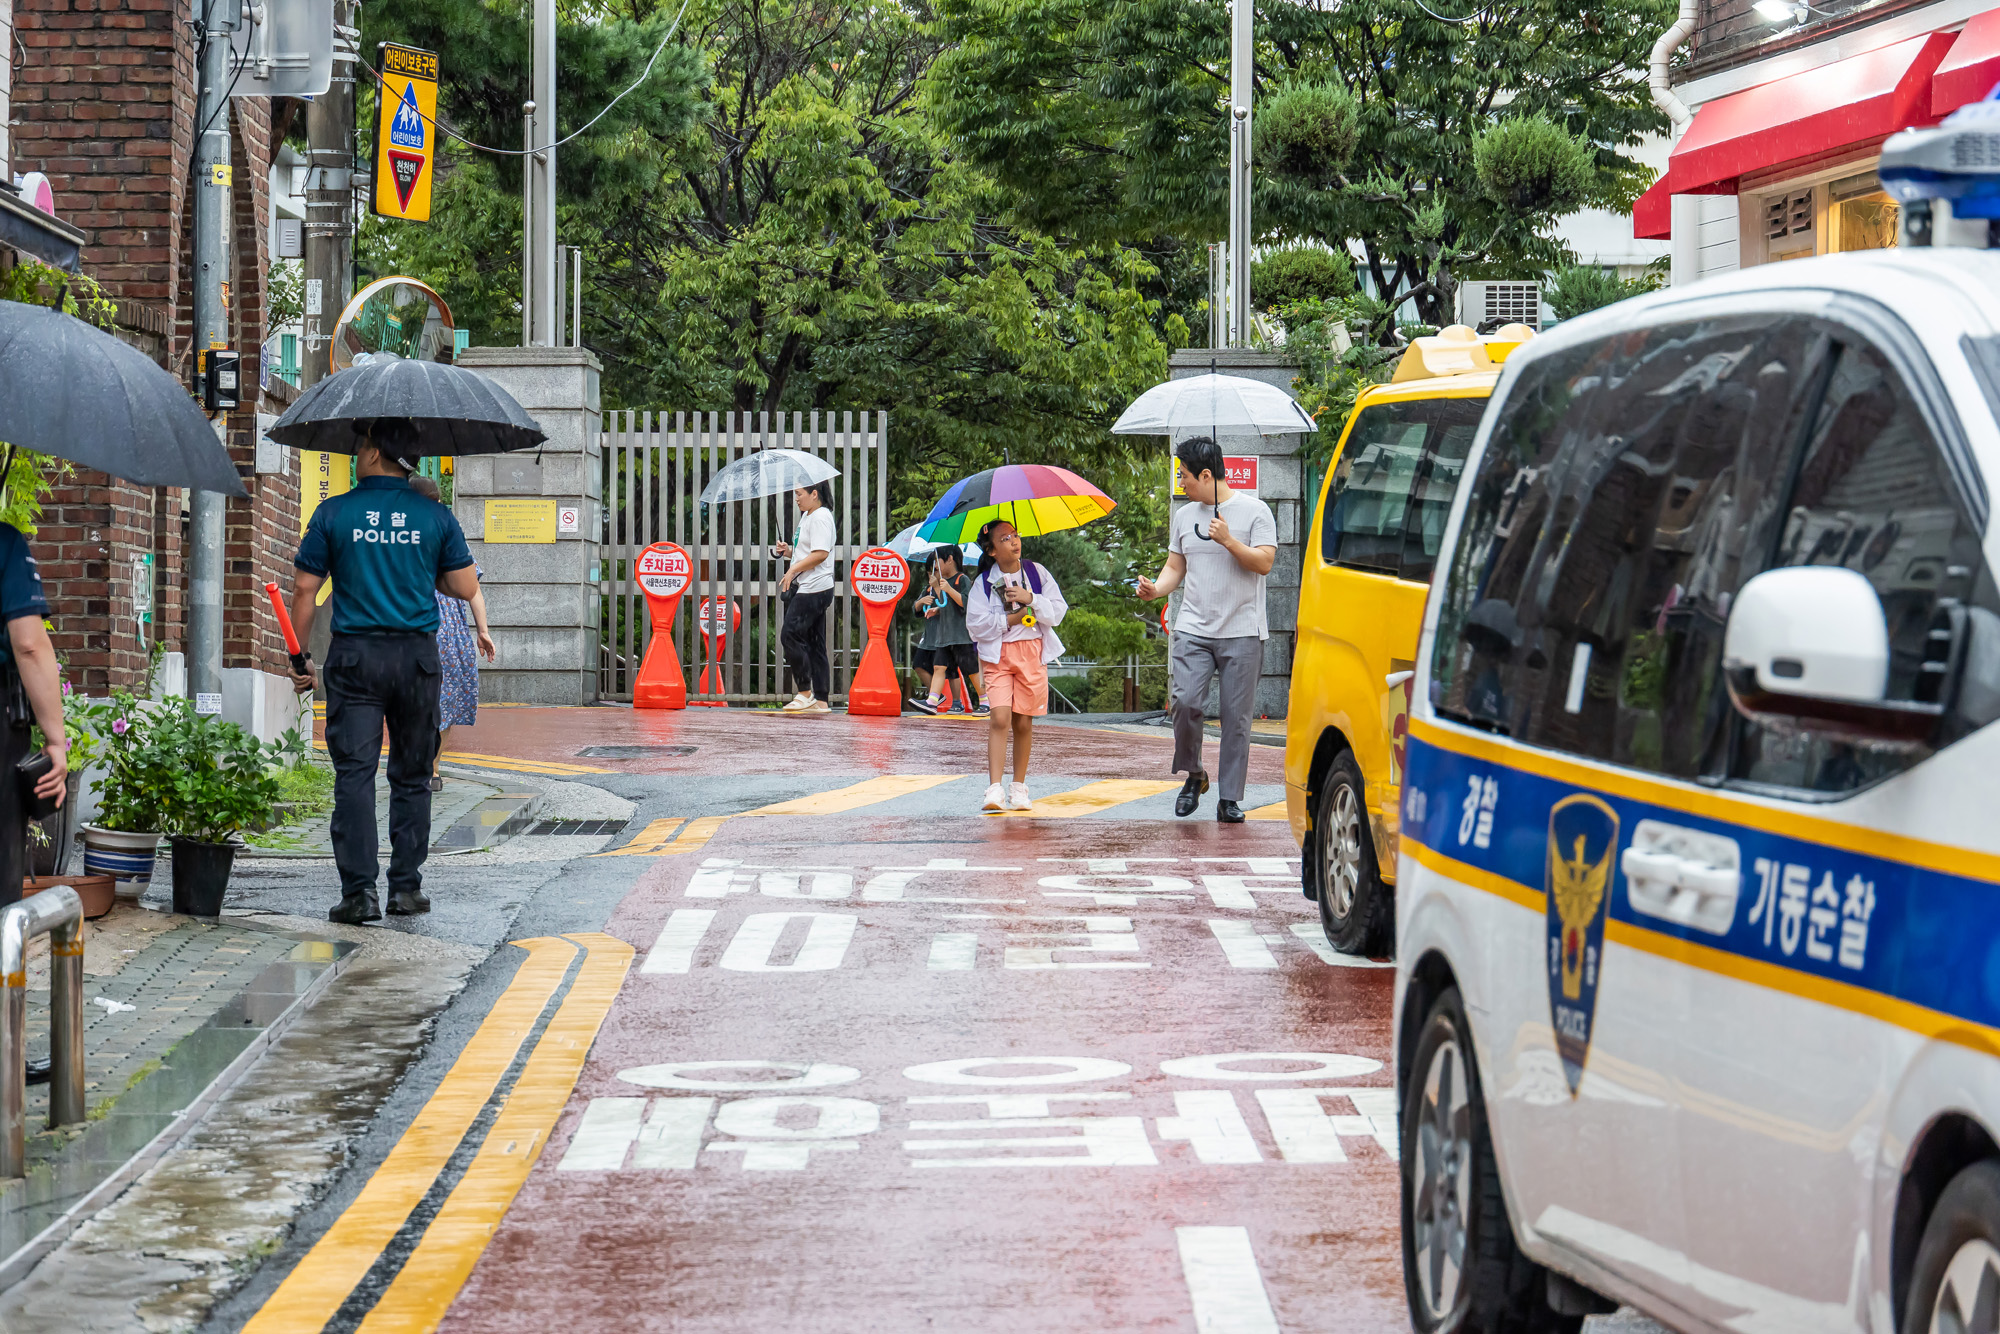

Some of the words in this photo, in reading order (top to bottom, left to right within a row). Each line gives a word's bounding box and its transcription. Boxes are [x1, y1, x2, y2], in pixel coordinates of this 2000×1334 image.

[386, 48, 437, 77] 어린이보호구역
[392, 130, 422, 147] 어린이보호
[396, 159, 416, 175] 천천히
[319, 453, 330, 477] 린이
[1225, 468, 1251, 479] 에스원
[353, 529, 421, 545] POLICE
[644, 558, 684, 572] 주차금지
[860, 563, 900, 578] 주차금지
[1458, 774, 1499, 849] 경찰
[1748, 857, 1876, 971] 기동순찰
